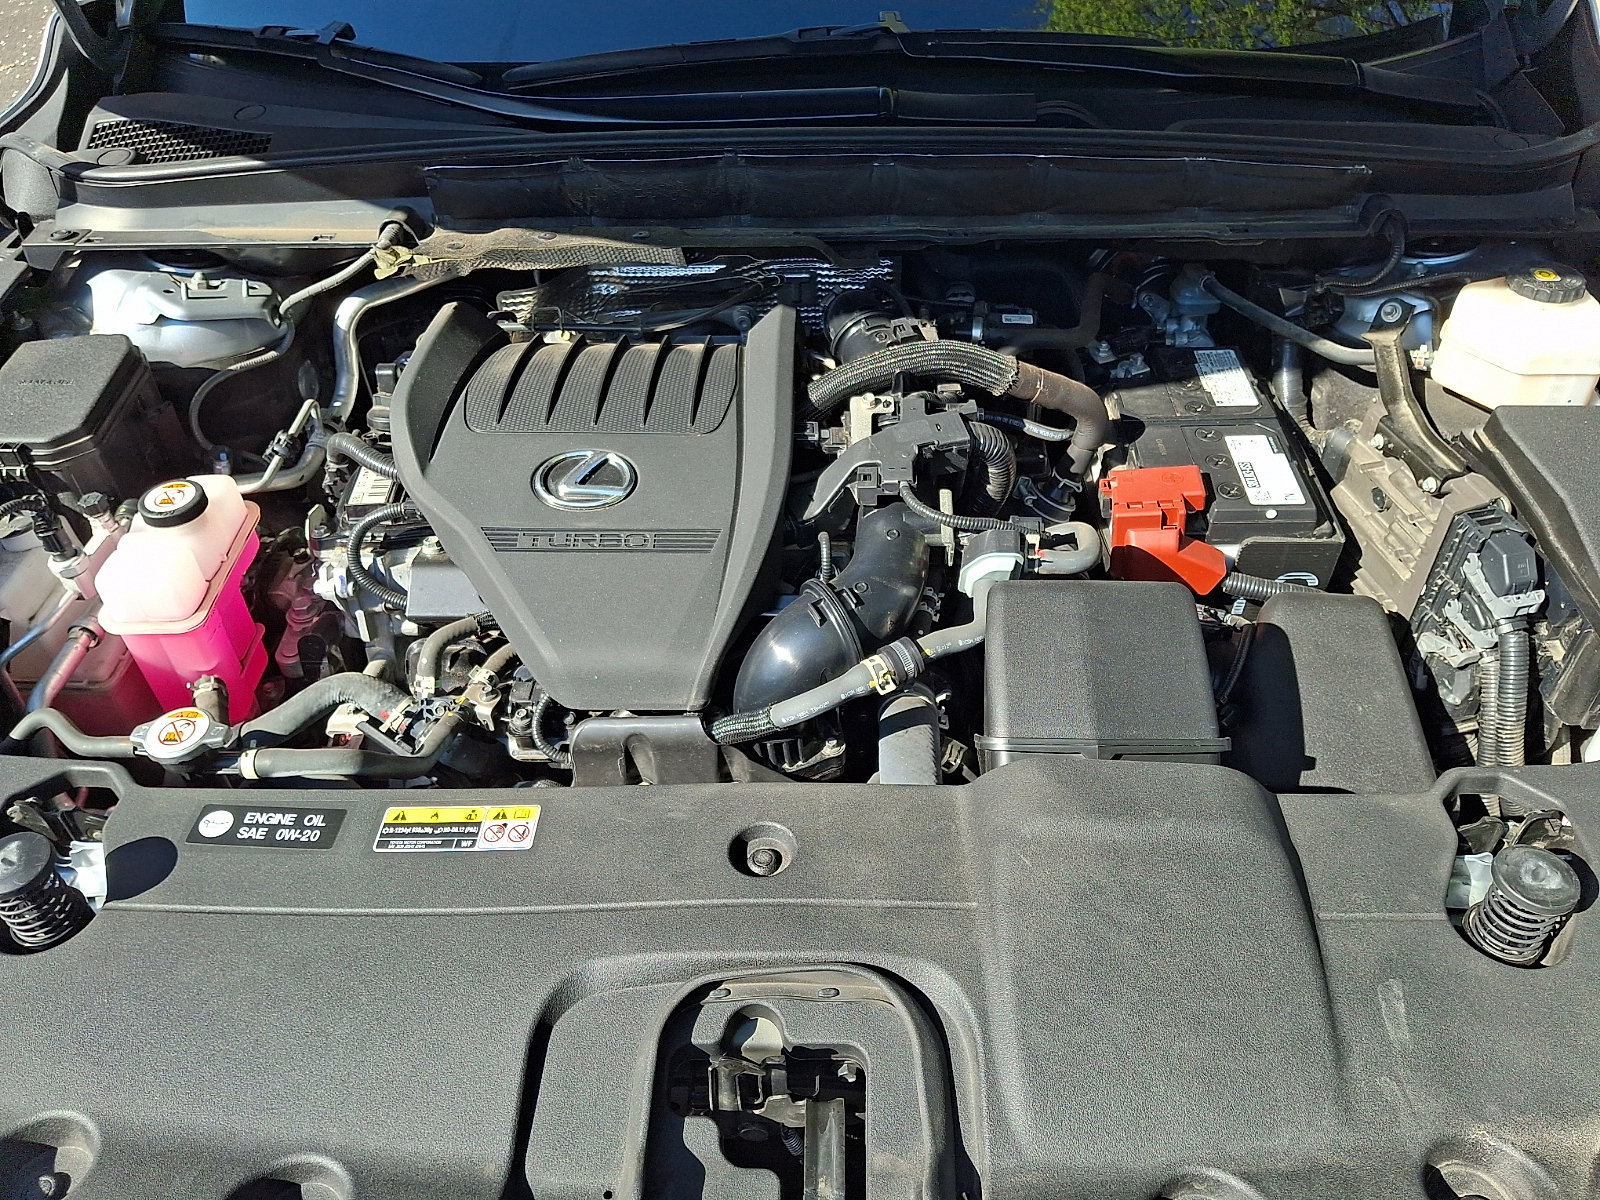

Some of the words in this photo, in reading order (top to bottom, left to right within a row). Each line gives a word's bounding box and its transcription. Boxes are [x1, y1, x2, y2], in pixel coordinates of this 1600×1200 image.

[522, 532, 650, 548] TURBO
[244, 812, 297, 826] ENGINE
[303, 814, 327, 827] OIL
[236, 827, 269, 840] SAE
[275, 828, 321, 842] 0W-20
